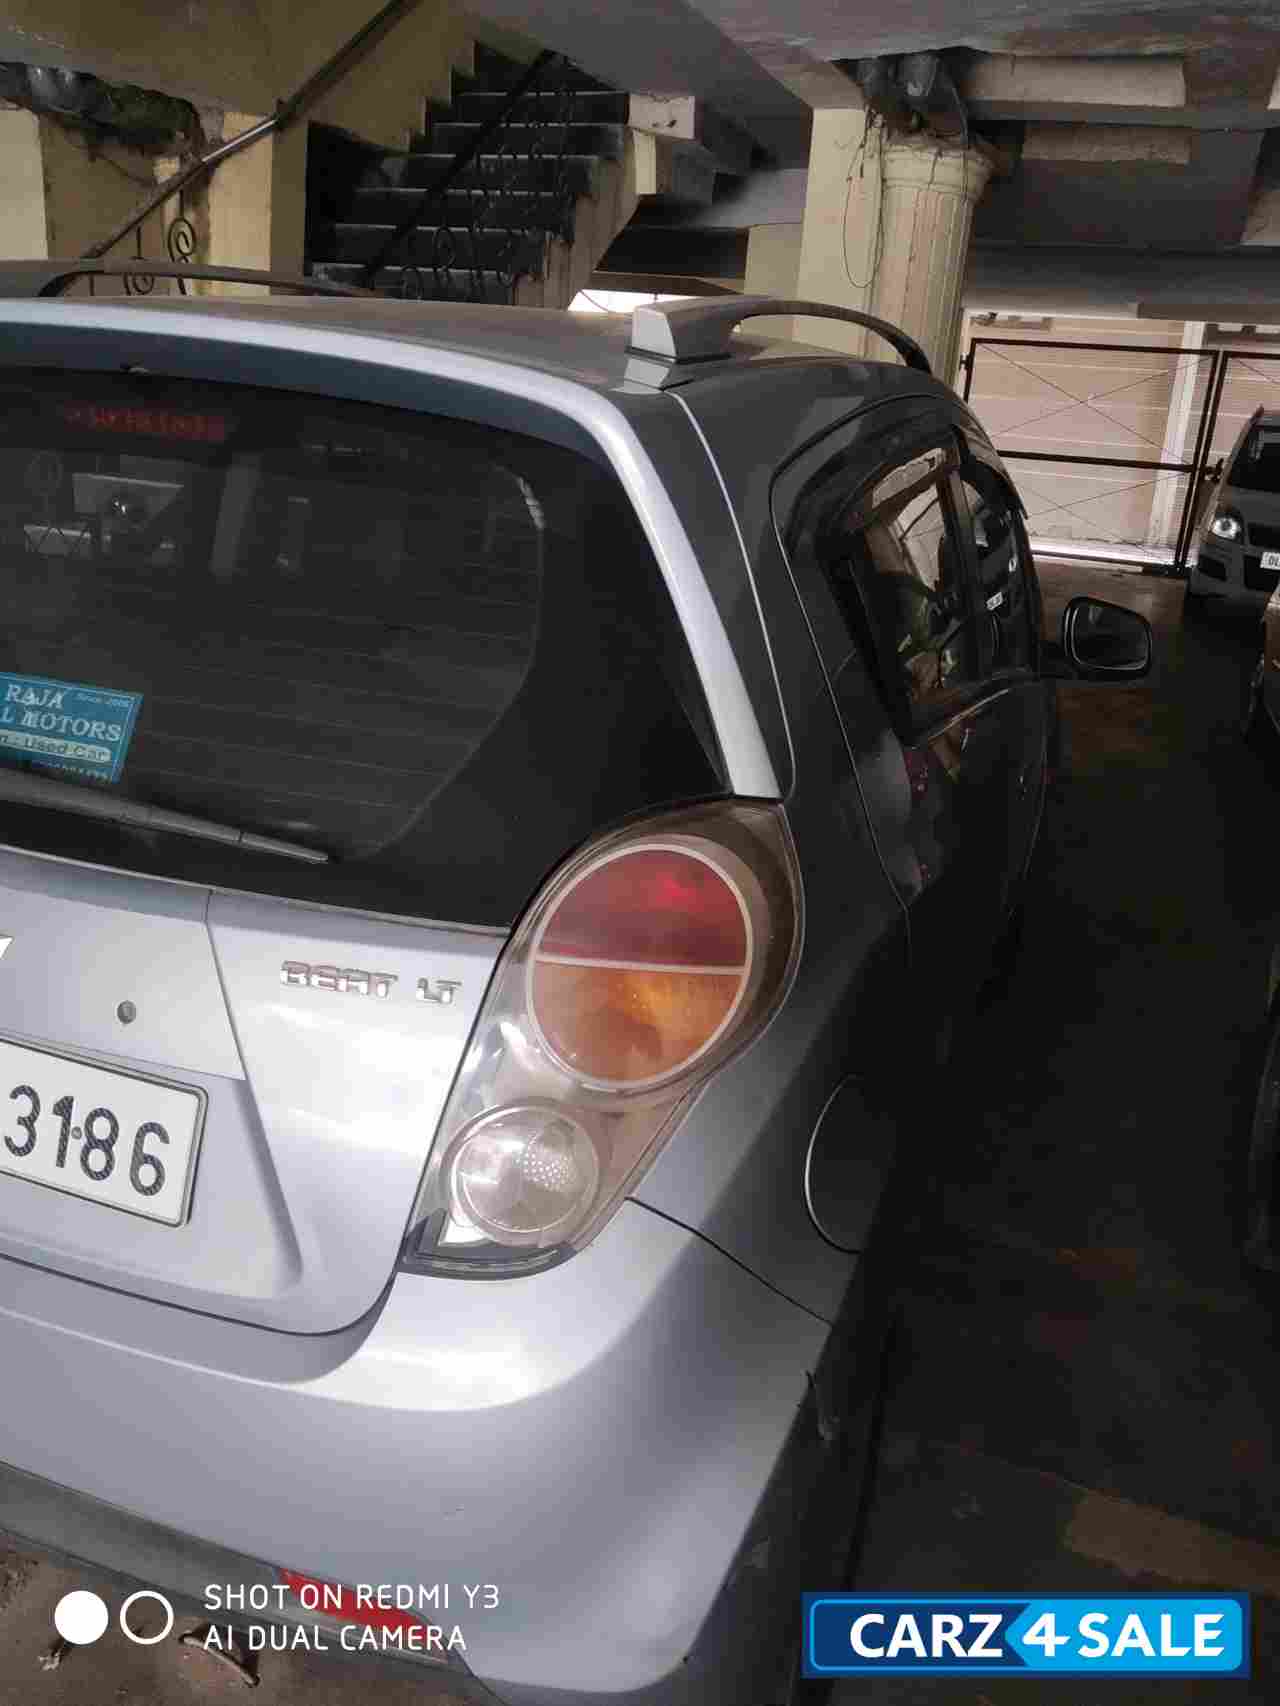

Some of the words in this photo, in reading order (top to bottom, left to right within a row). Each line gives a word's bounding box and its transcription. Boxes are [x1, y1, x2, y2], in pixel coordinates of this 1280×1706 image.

[5, 684, 64, 709] RAJA
[20, 710, 122, 742] MOTORS
[281, 960, 398, 999] BEAT
[417, 977, 463, 1005] LT
[4, 1084, 170, 1196] 3186
